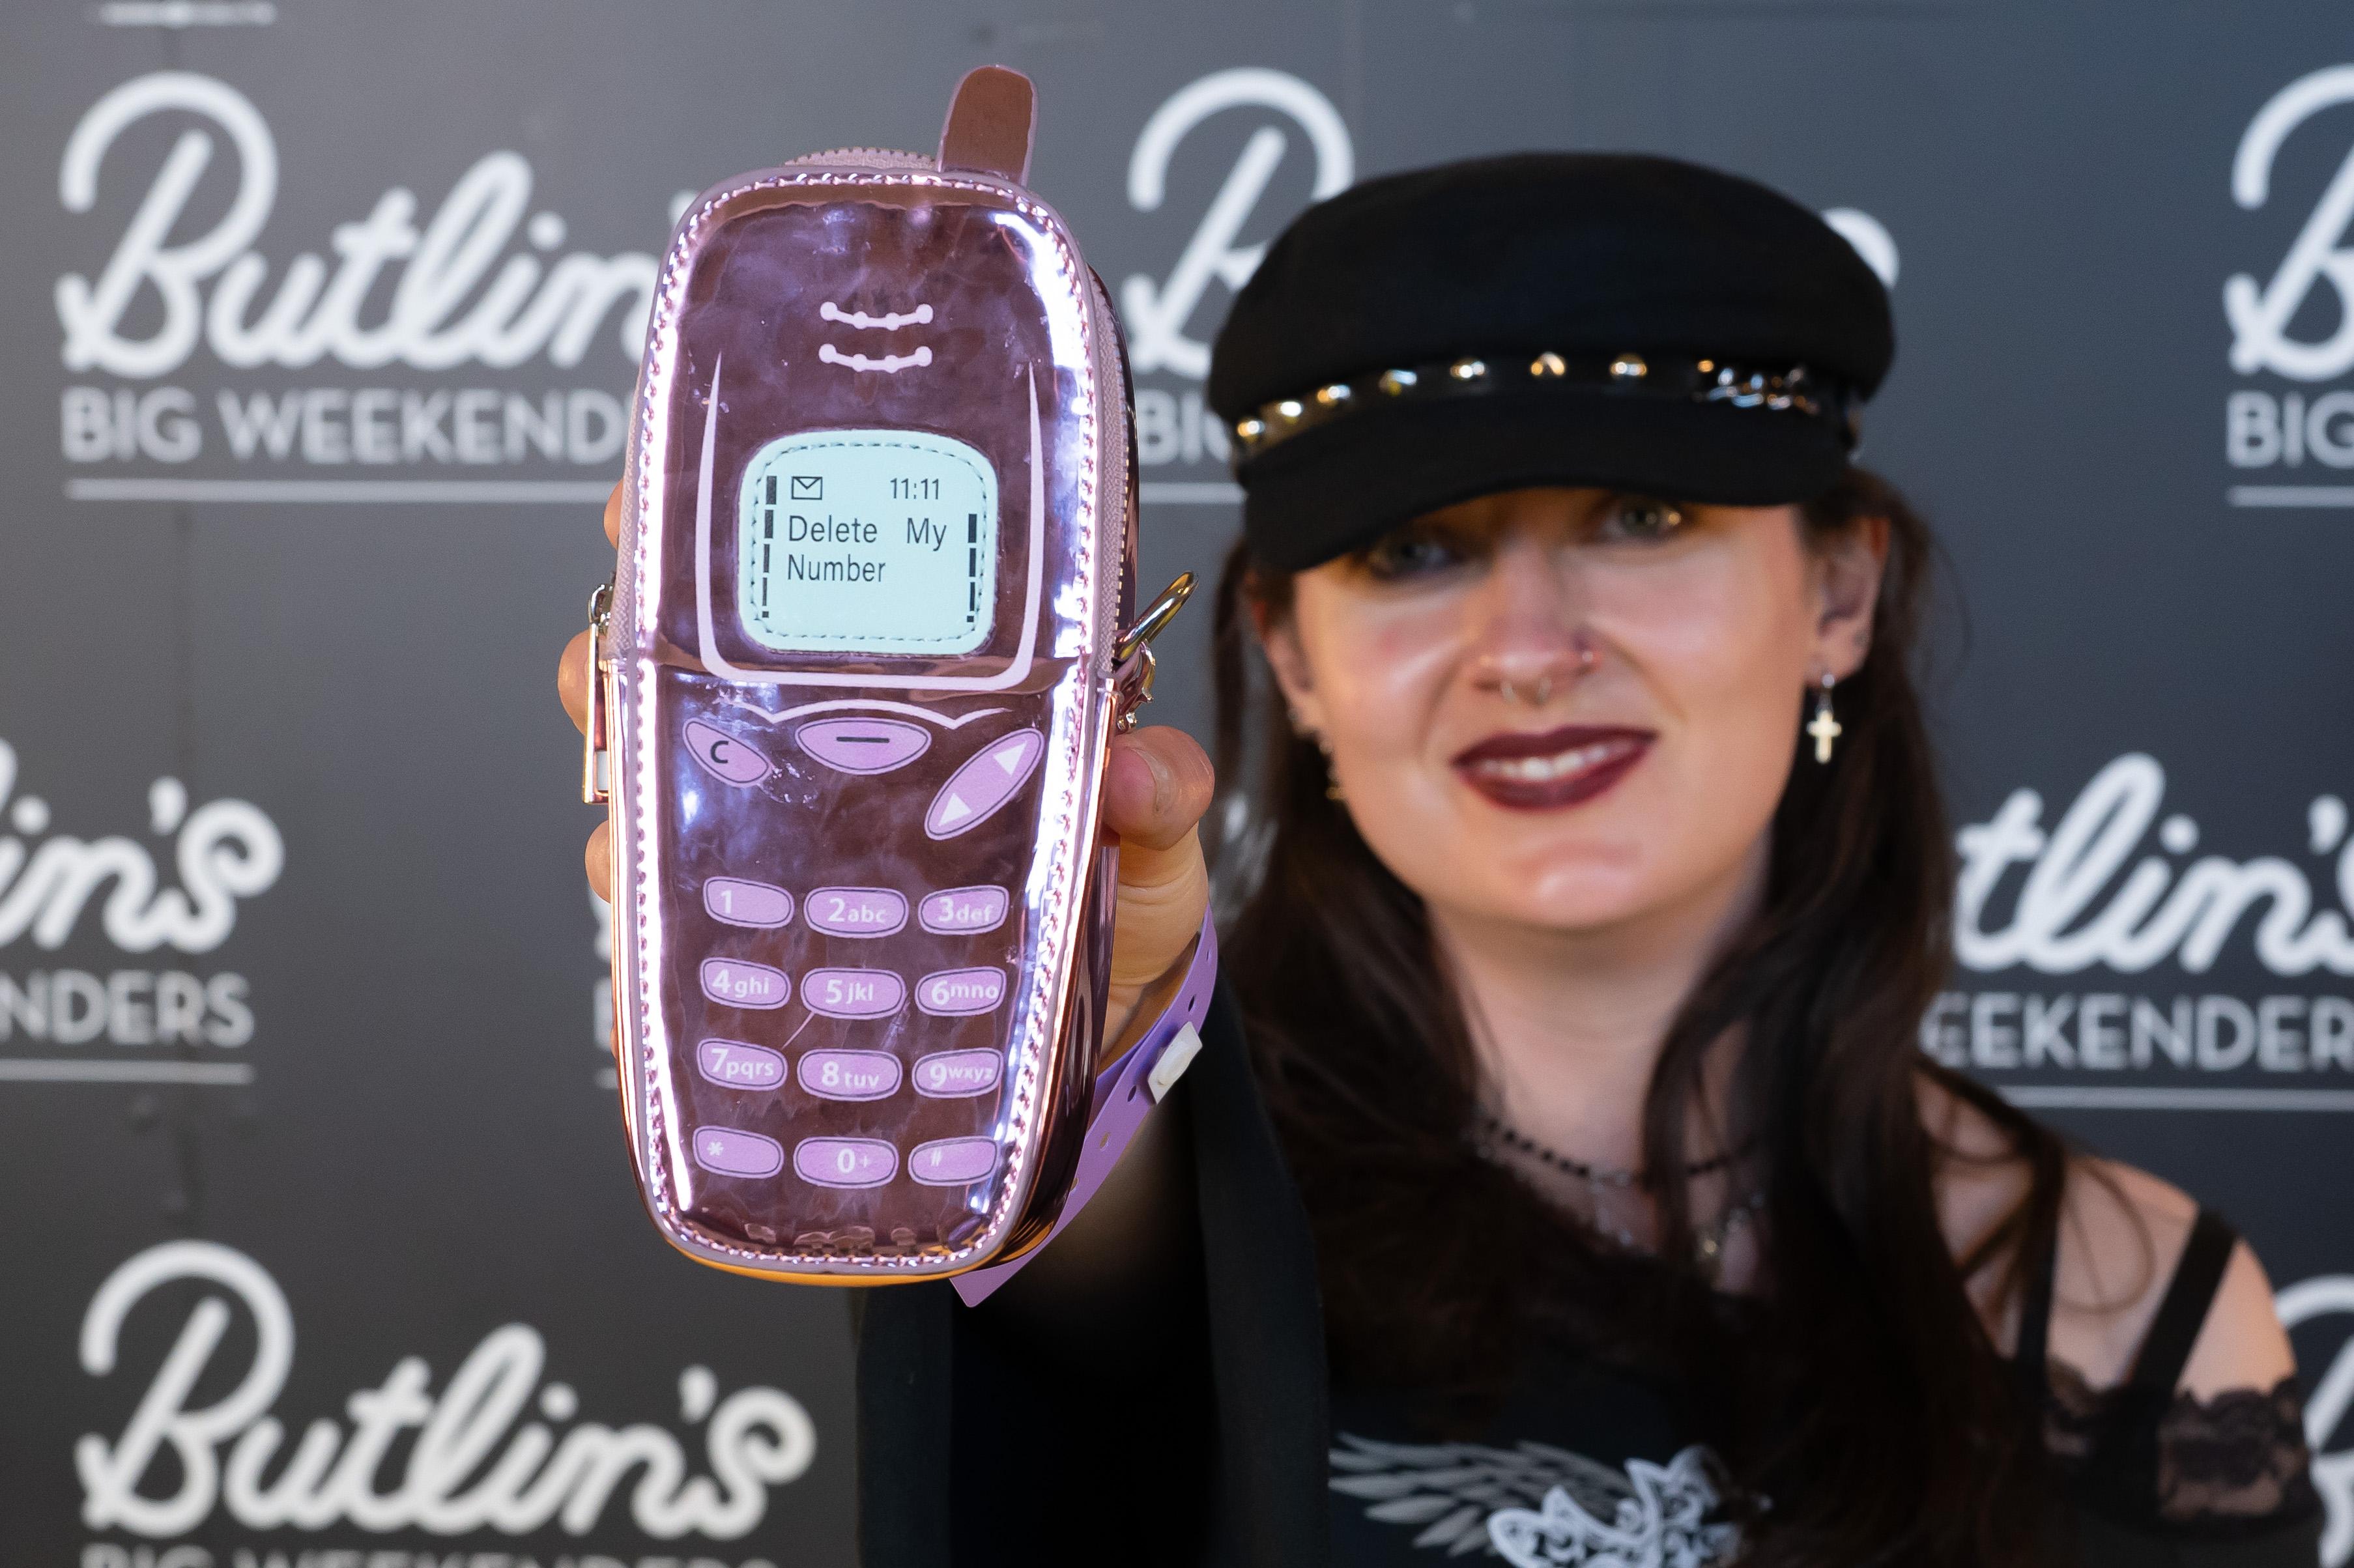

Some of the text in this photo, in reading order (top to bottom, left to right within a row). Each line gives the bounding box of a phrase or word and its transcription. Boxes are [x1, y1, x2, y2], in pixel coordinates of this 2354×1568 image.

[61, 386, 635, 465] BIG WEEKEND
[890, 478, 940, 500] 11:11
[788, 515, 947, 552] Delete My
[787, 554, 886, 582] Number
[721, 890, 732, 913] 1
[76, 1240, 816, 1540] Butlin's
